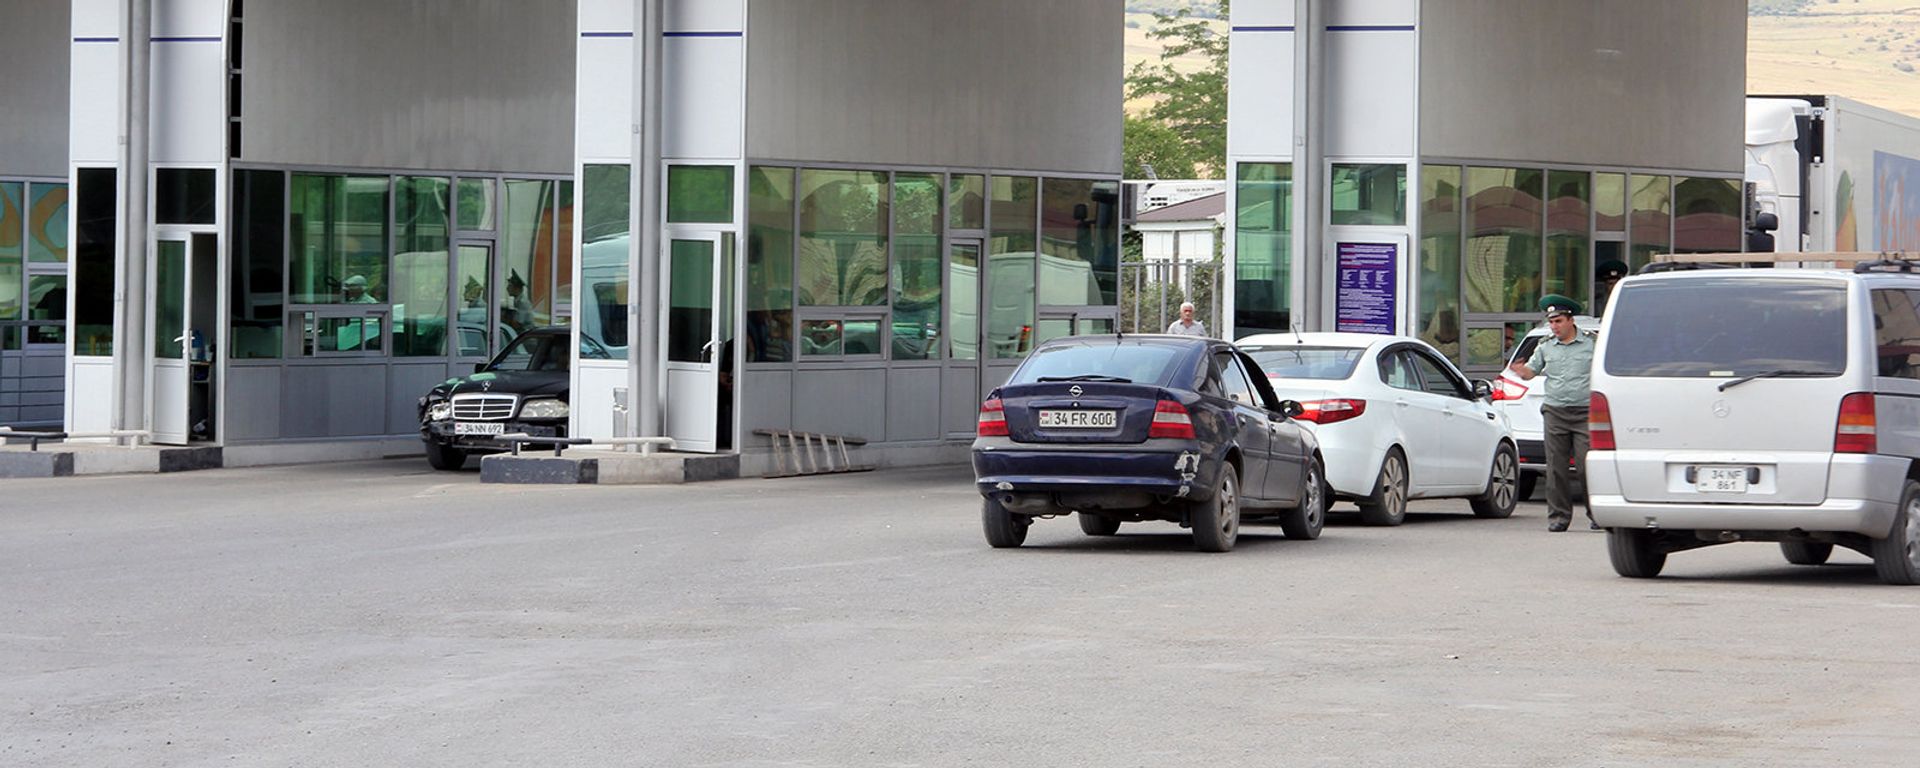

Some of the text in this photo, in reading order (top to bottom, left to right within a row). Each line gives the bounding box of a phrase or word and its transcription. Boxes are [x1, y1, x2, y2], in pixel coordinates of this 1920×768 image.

[1054, 412, 1112, 425] 34 FR 600
[464, 424, 474, 433] 34
[1712, 470, 1742, 479] 34 NF
